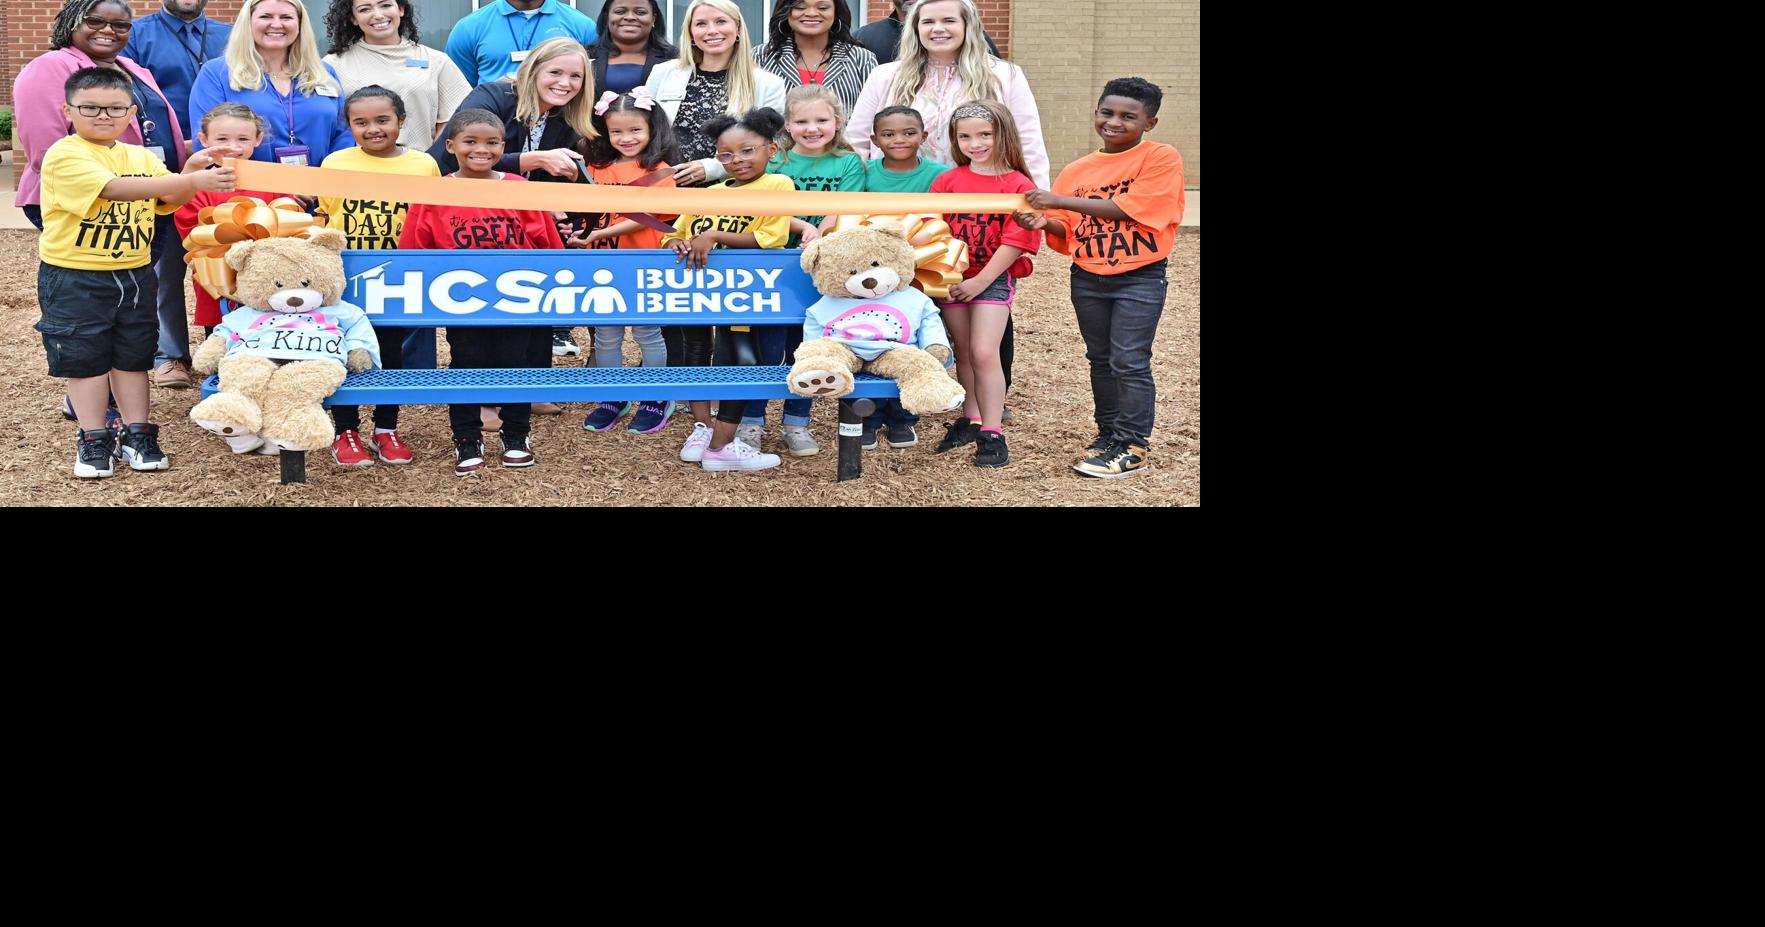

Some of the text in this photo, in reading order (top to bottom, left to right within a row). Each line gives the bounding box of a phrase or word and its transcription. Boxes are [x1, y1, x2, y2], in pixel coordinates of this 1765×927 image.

[342, 198, 409, 215] GREA
[342, 213, 393, 236] DAY
[75, 222, 153, 250] TITAN
[344, 236, 398, 249] TITA
[636, 268, 785, 289] BUDDY
[636, 291, 782, 313] BENCH
[271, 330, 343, 355] Kind
